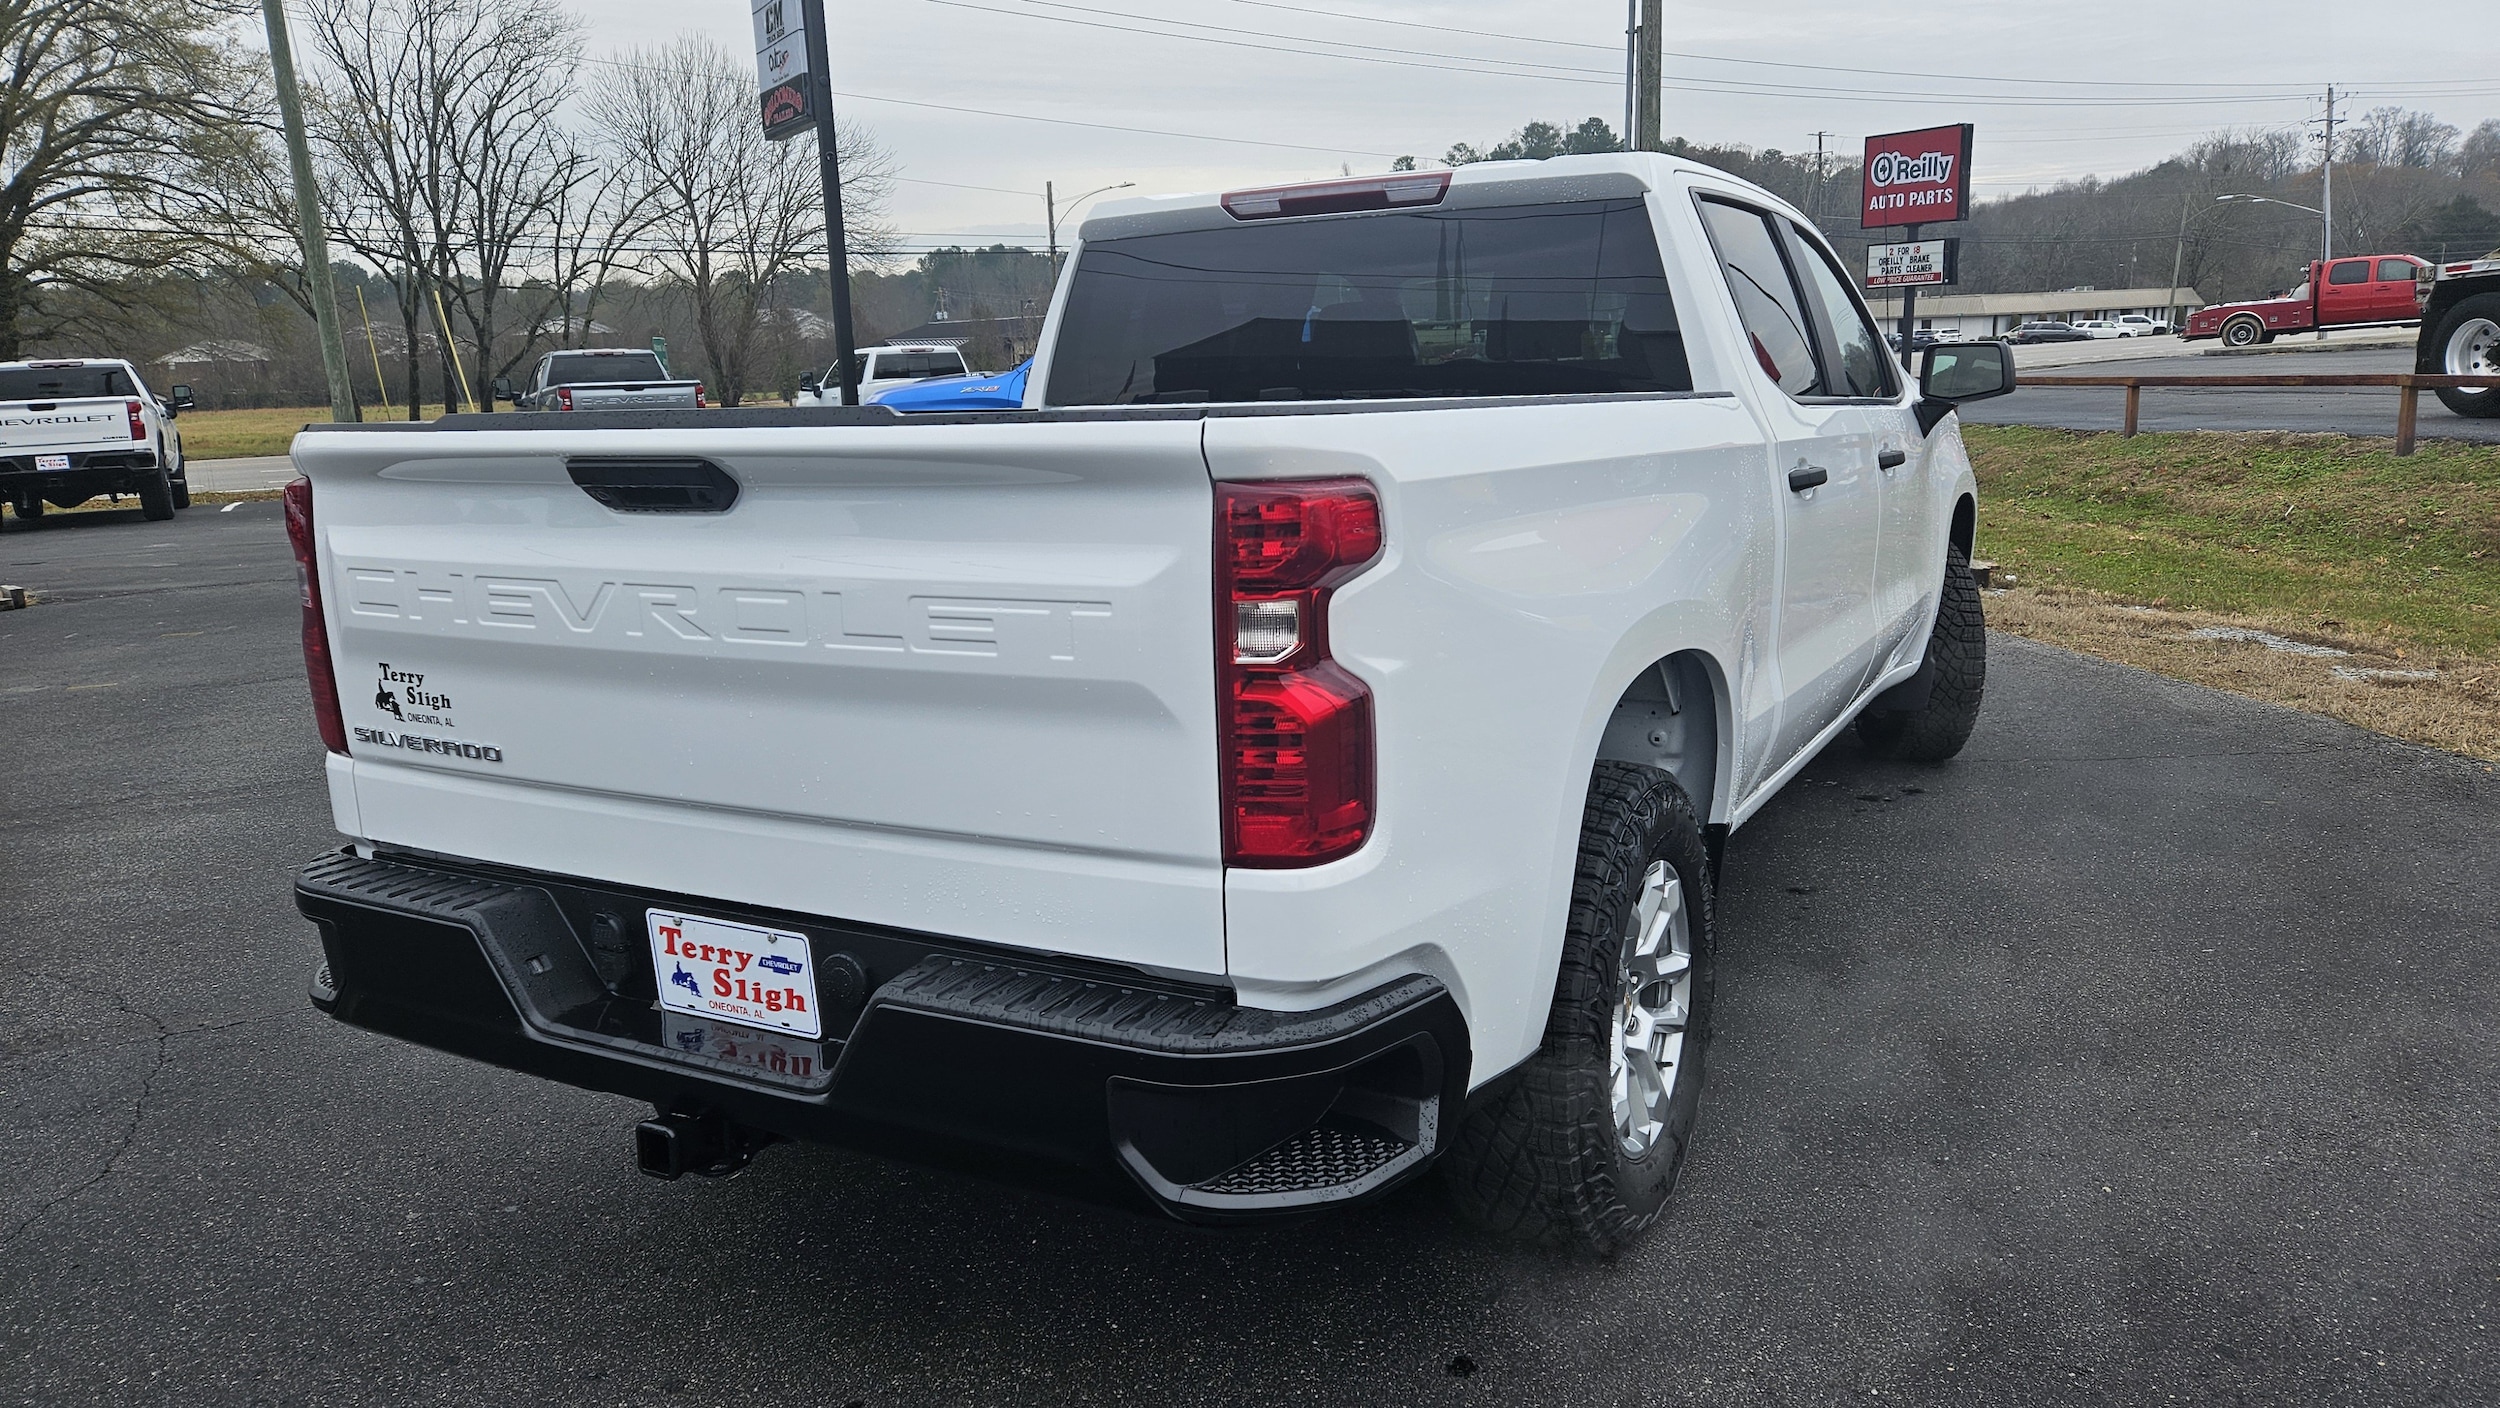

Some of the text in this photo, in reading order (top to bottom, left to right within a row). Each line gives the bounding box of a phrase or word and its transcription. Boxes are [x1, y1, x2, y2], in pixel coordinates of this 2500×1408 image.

[765, 0, 783, 34] CM
[1872, 153, 1951, 185] O'Reilly
[1869, 188, 1953, 211] AUTO PARTS
[1889, 248, 1894, 256] 2
[1897, 246, 1910, 256] FOR
[1909, 254, 1930, 264] BRAKE
[1873, 273, 1934, 285] LOW PRICE GUARANTEE
[1881, 263, 1933, 275] PARTS CLEANER
[346, 567, 1113, 660] CHEVROLET
[379, 662, 424, 687] Terry
[406, 686, 452, 710] Sligh
[407, 712, 455, 727] ONEONTA, AL
[354, 726, 503, 762] SILVERADO
[659, 925, 753, 972] Terry
[762, 958, 799, 972] CHEVROLET
[713, 968, 807, 1012] Sligh
[708, 1000, 765, 1019] ONEONTA, AL
